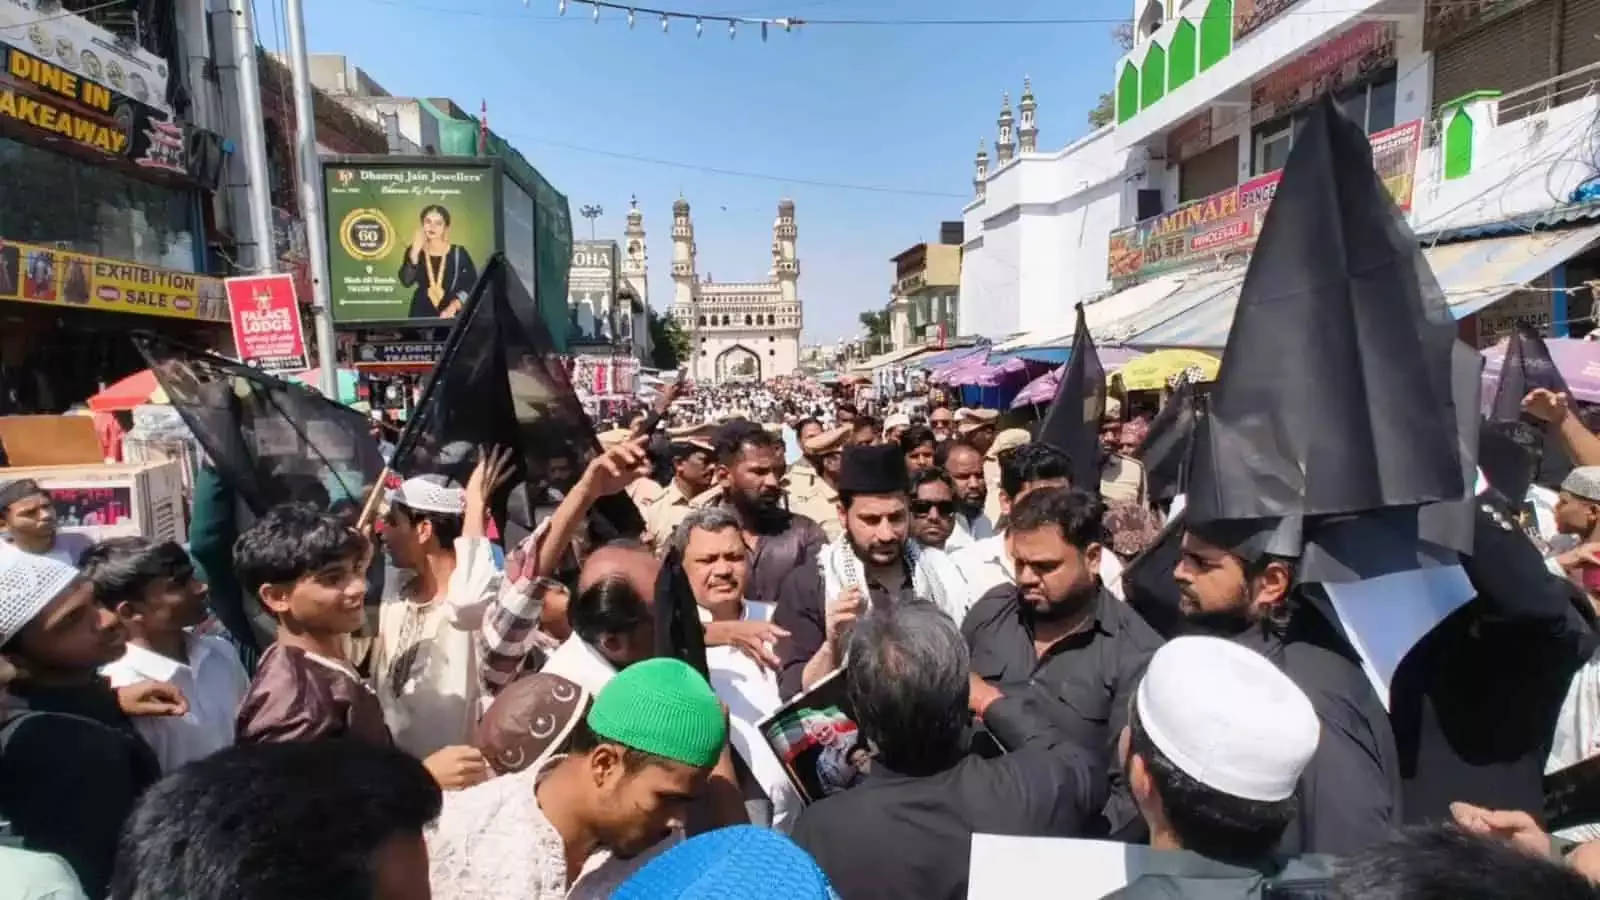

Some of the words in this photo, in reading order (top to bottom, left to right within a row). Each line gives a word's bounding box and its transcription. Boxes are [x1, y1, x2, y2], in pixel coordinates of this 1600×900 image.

[9, 49, 77, 99] DINE
[81, 80, 111, 111] IN
[360, 171, 405, 183] Dhanraj
[406, 171, 428, 183] Jain
[431, 171, 481, 183] Jewellers
[1151, 191, 1237, 236] AMINAH
[359, 230, 378, 242] 60
[1193, 222, 1243, 248] WHOLESALE
[96, 262, 195, 291] EXHIBITION
[126, 289, 168, 308] SALE
[240, 307, 289, 321] PALACE
[243, 319, 292, 335] LODGE
